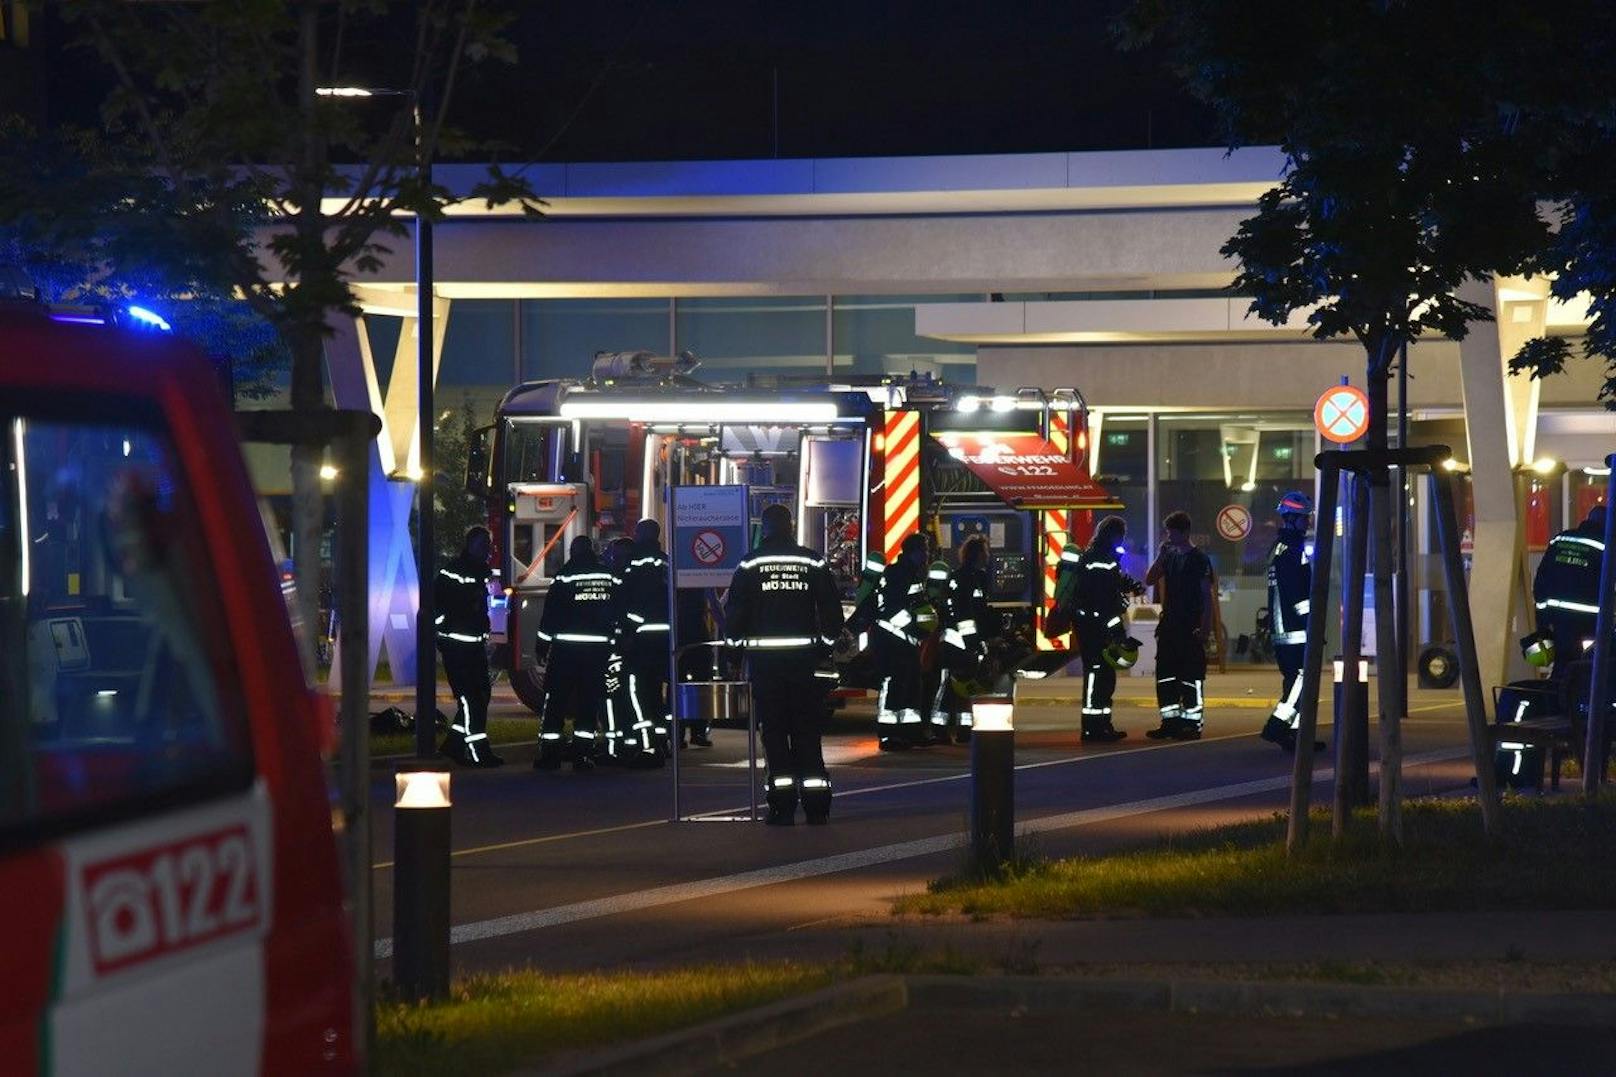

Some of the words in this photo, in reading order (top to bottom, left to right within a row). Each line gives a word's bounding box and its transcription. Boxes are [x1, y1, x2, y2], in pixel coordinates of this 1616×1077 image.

[962, 455, 1070, 464] FEERWEHR
[1017, 465, 1058, 476] 122
[154, 838, 259, 943] 122
